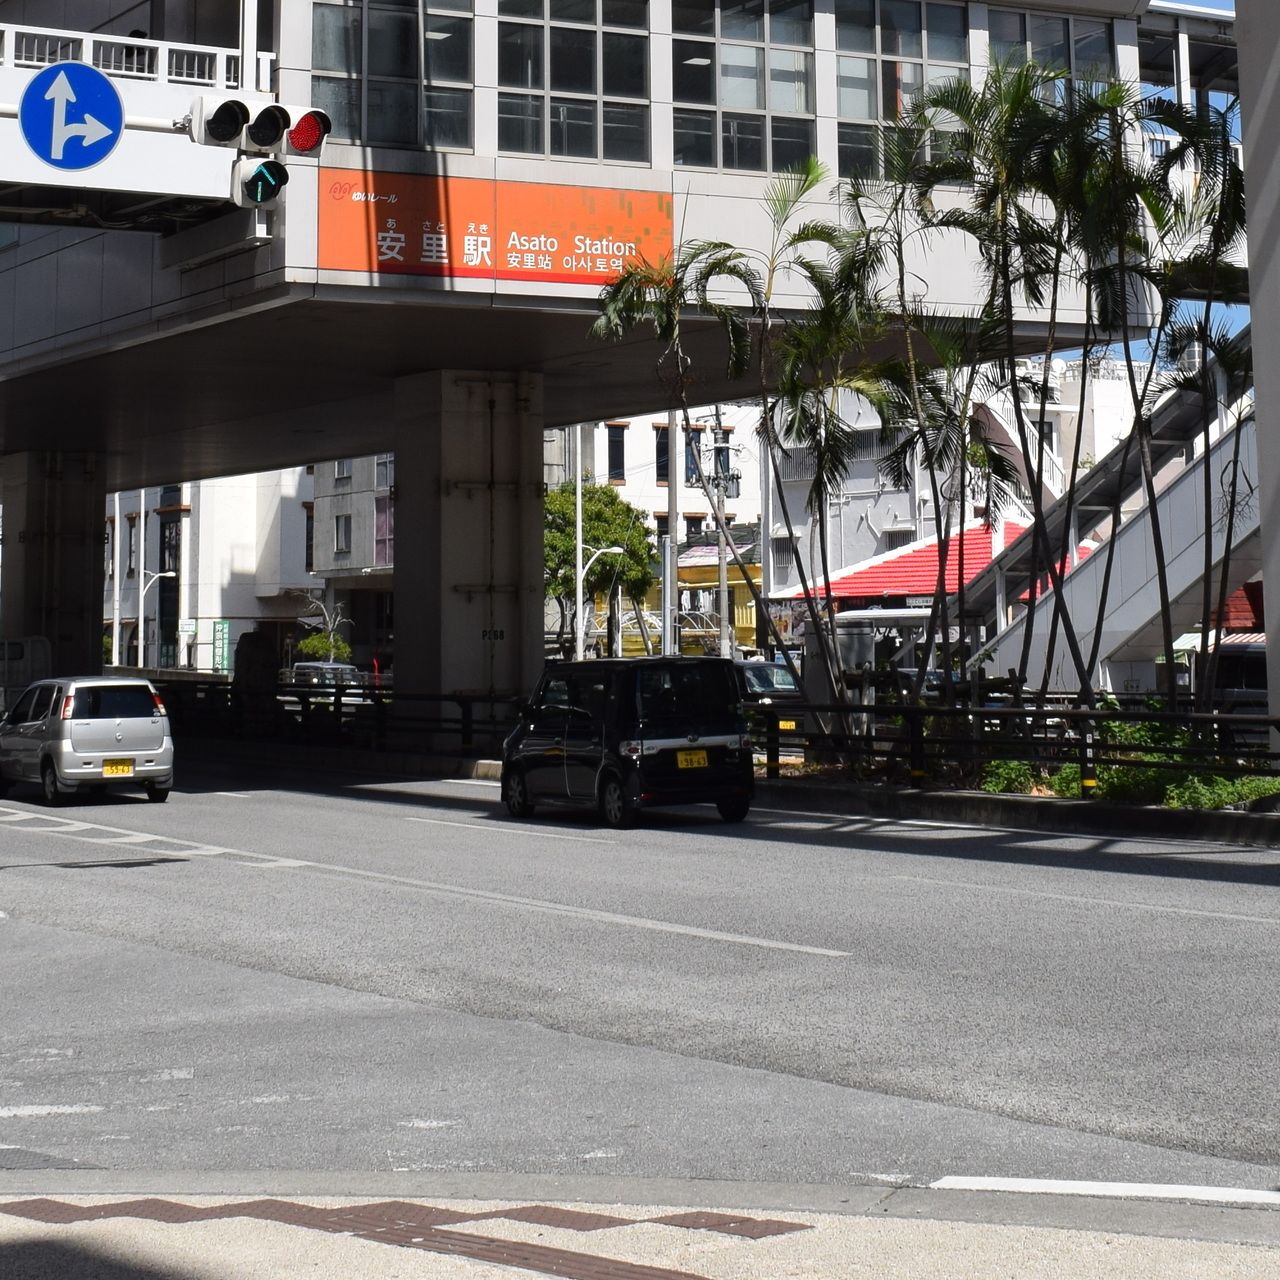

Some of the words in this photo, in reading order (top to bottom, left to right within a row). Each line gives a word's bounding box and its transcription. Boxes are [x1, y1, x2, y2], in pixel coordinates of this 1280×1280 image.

[351, 192, 398, 203] ゆいレール
[377, 230, 492, 267] 安里駅
[507, 231, 558, 252] Asato
[574, 235, 636, 257] Station
[507, 252, 552, 269] 安里站
